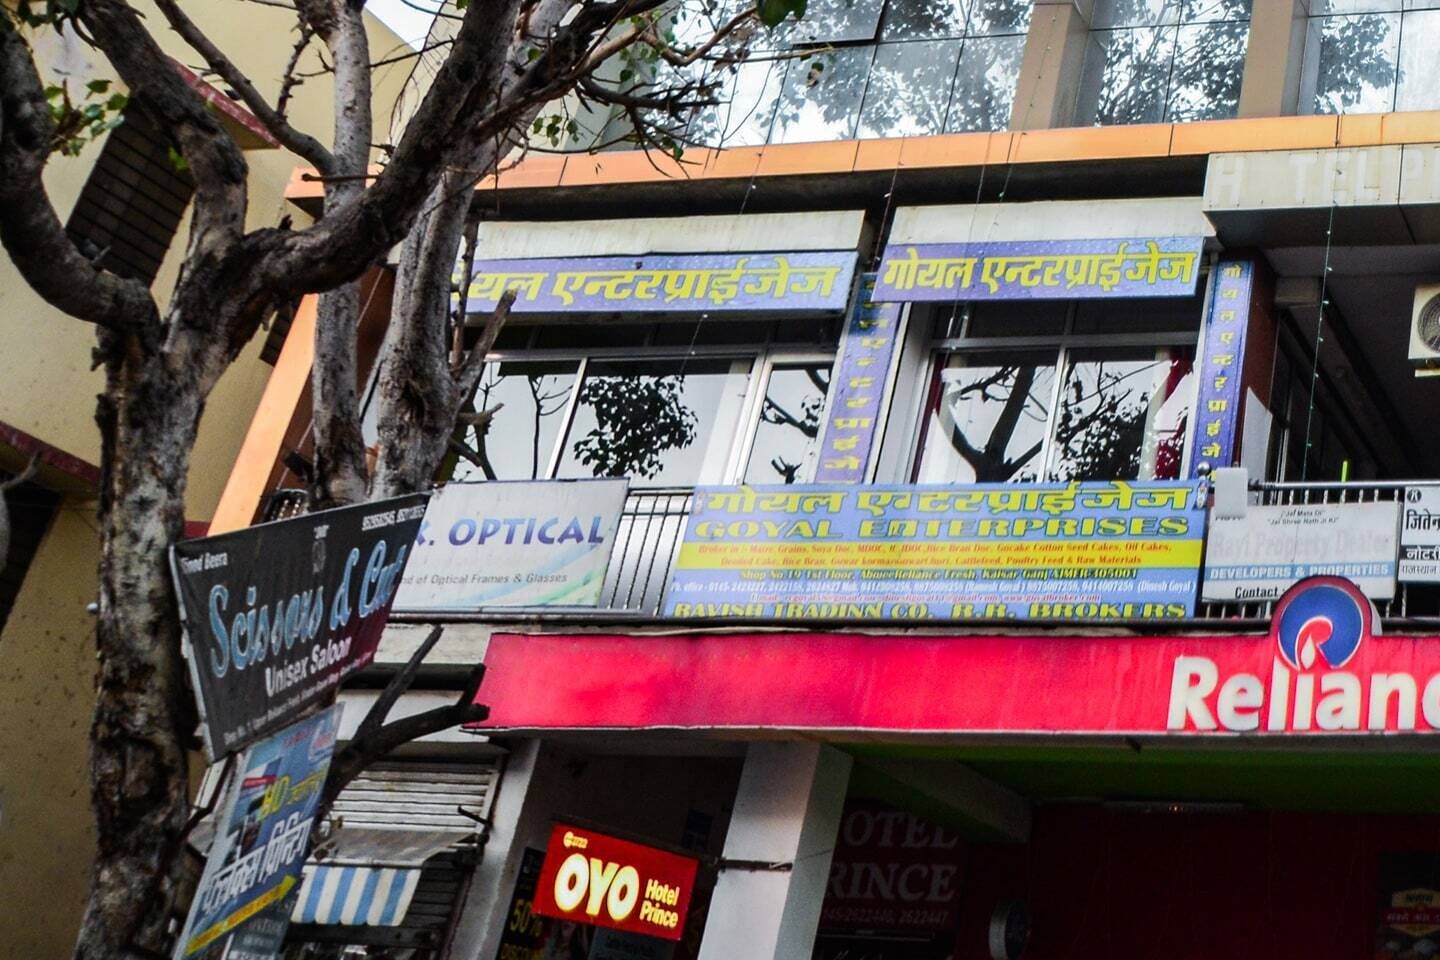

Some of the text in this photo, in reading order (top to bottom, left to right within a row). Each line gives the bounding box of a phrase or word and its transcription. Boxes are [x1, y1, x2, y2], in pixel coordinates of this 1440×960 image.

[884, 247, 977, 289] गोयल
[707, 485, 849, 514] गोयल
[448, 514, 605, 546] OPTICAL
[694, 520, 844, 539] GOYAL
[415, 574, 429, 585] of
[430, 573, 469, 586] Optical
[471, 573, 509, 584] Frames
[526, 572, 567, 584] Glasses
[1210, 563, 1389, 579] DEVELOPERS & PROPERTIES
[1234, 587, 1279, 599] Contact
[674, 603, 763, 619] RAVISH
[1028, 603, 1188, 619] BROKERS
[210, 584, 324, 679] Scissors
[265, 636, 352, 697] Unisex Saloon
[843, 808, 961, 849] OTEL
[554, 852, 640, 923] OYO
[645, 878, 681, 907] Hotel
[639, 900, 679, 929] Prince
